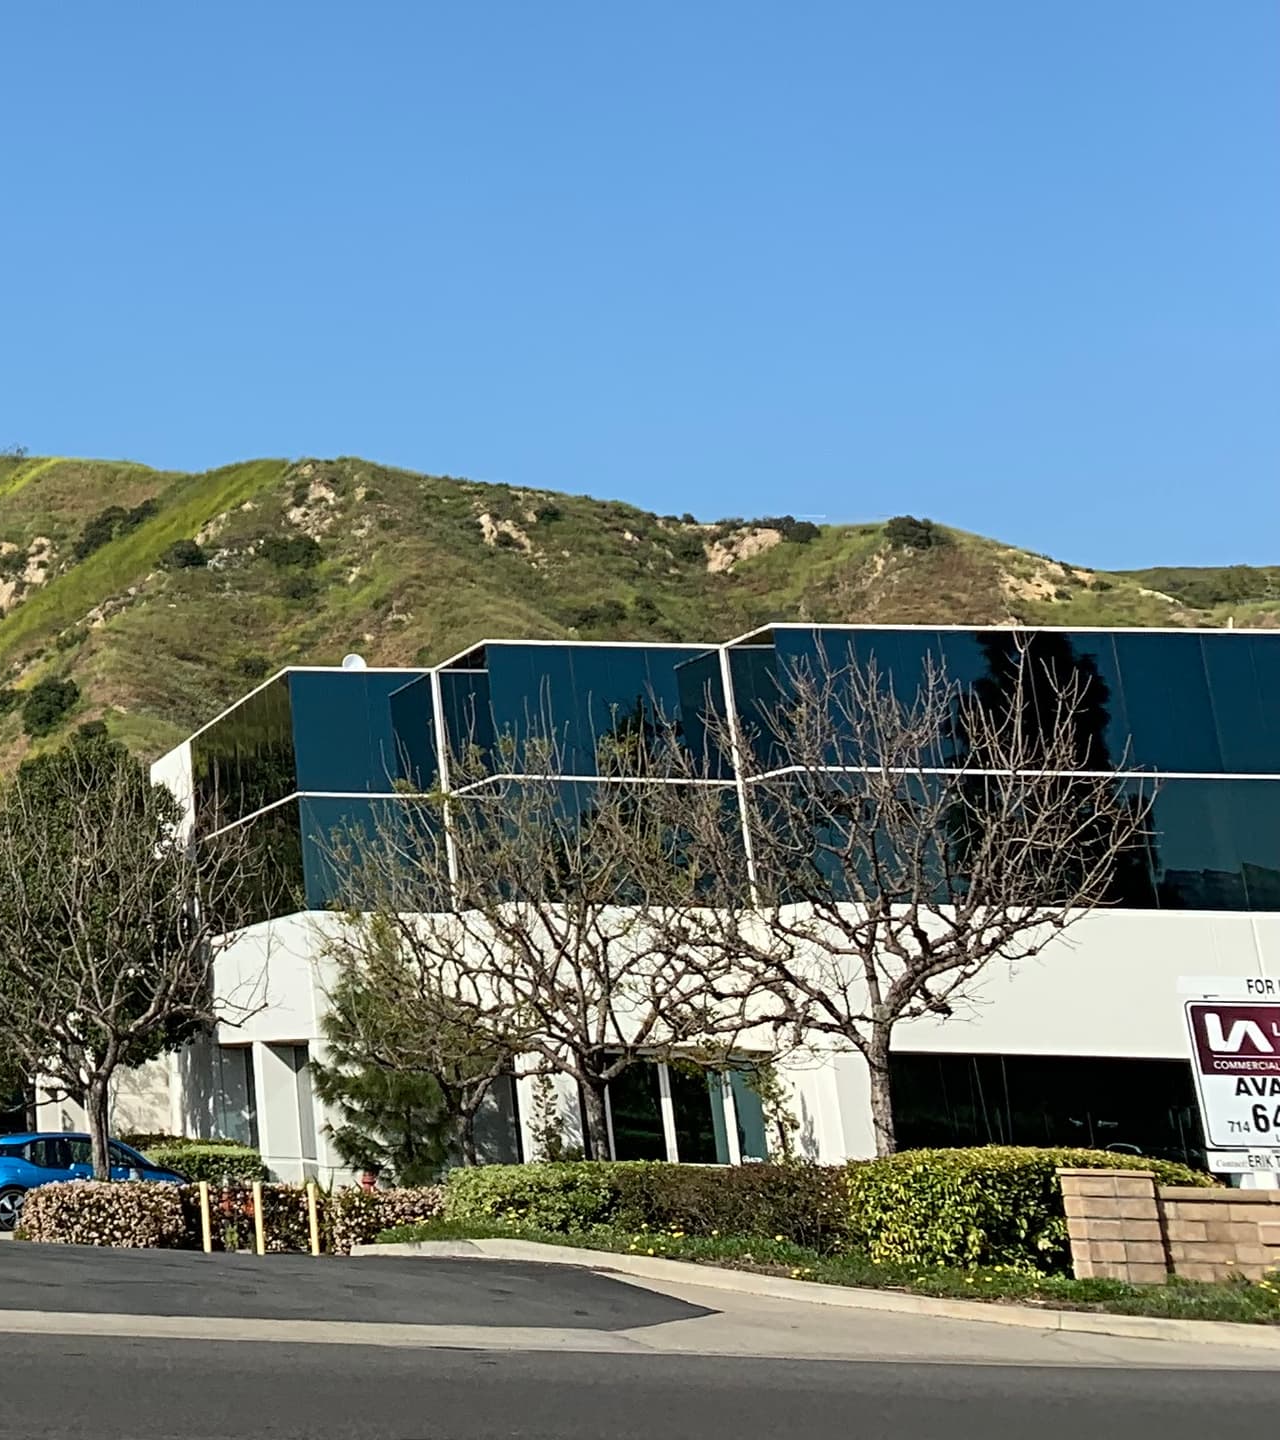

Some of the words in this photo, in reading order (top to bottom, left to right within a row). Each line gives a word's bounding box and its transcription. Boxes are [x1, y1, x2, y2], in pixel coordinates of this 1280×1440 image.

[1246, 979, 1275, 994] FOR
[1227, 1120, 1251, 1133] 714
[1248, 1154, 1273, 1168] ERIK
